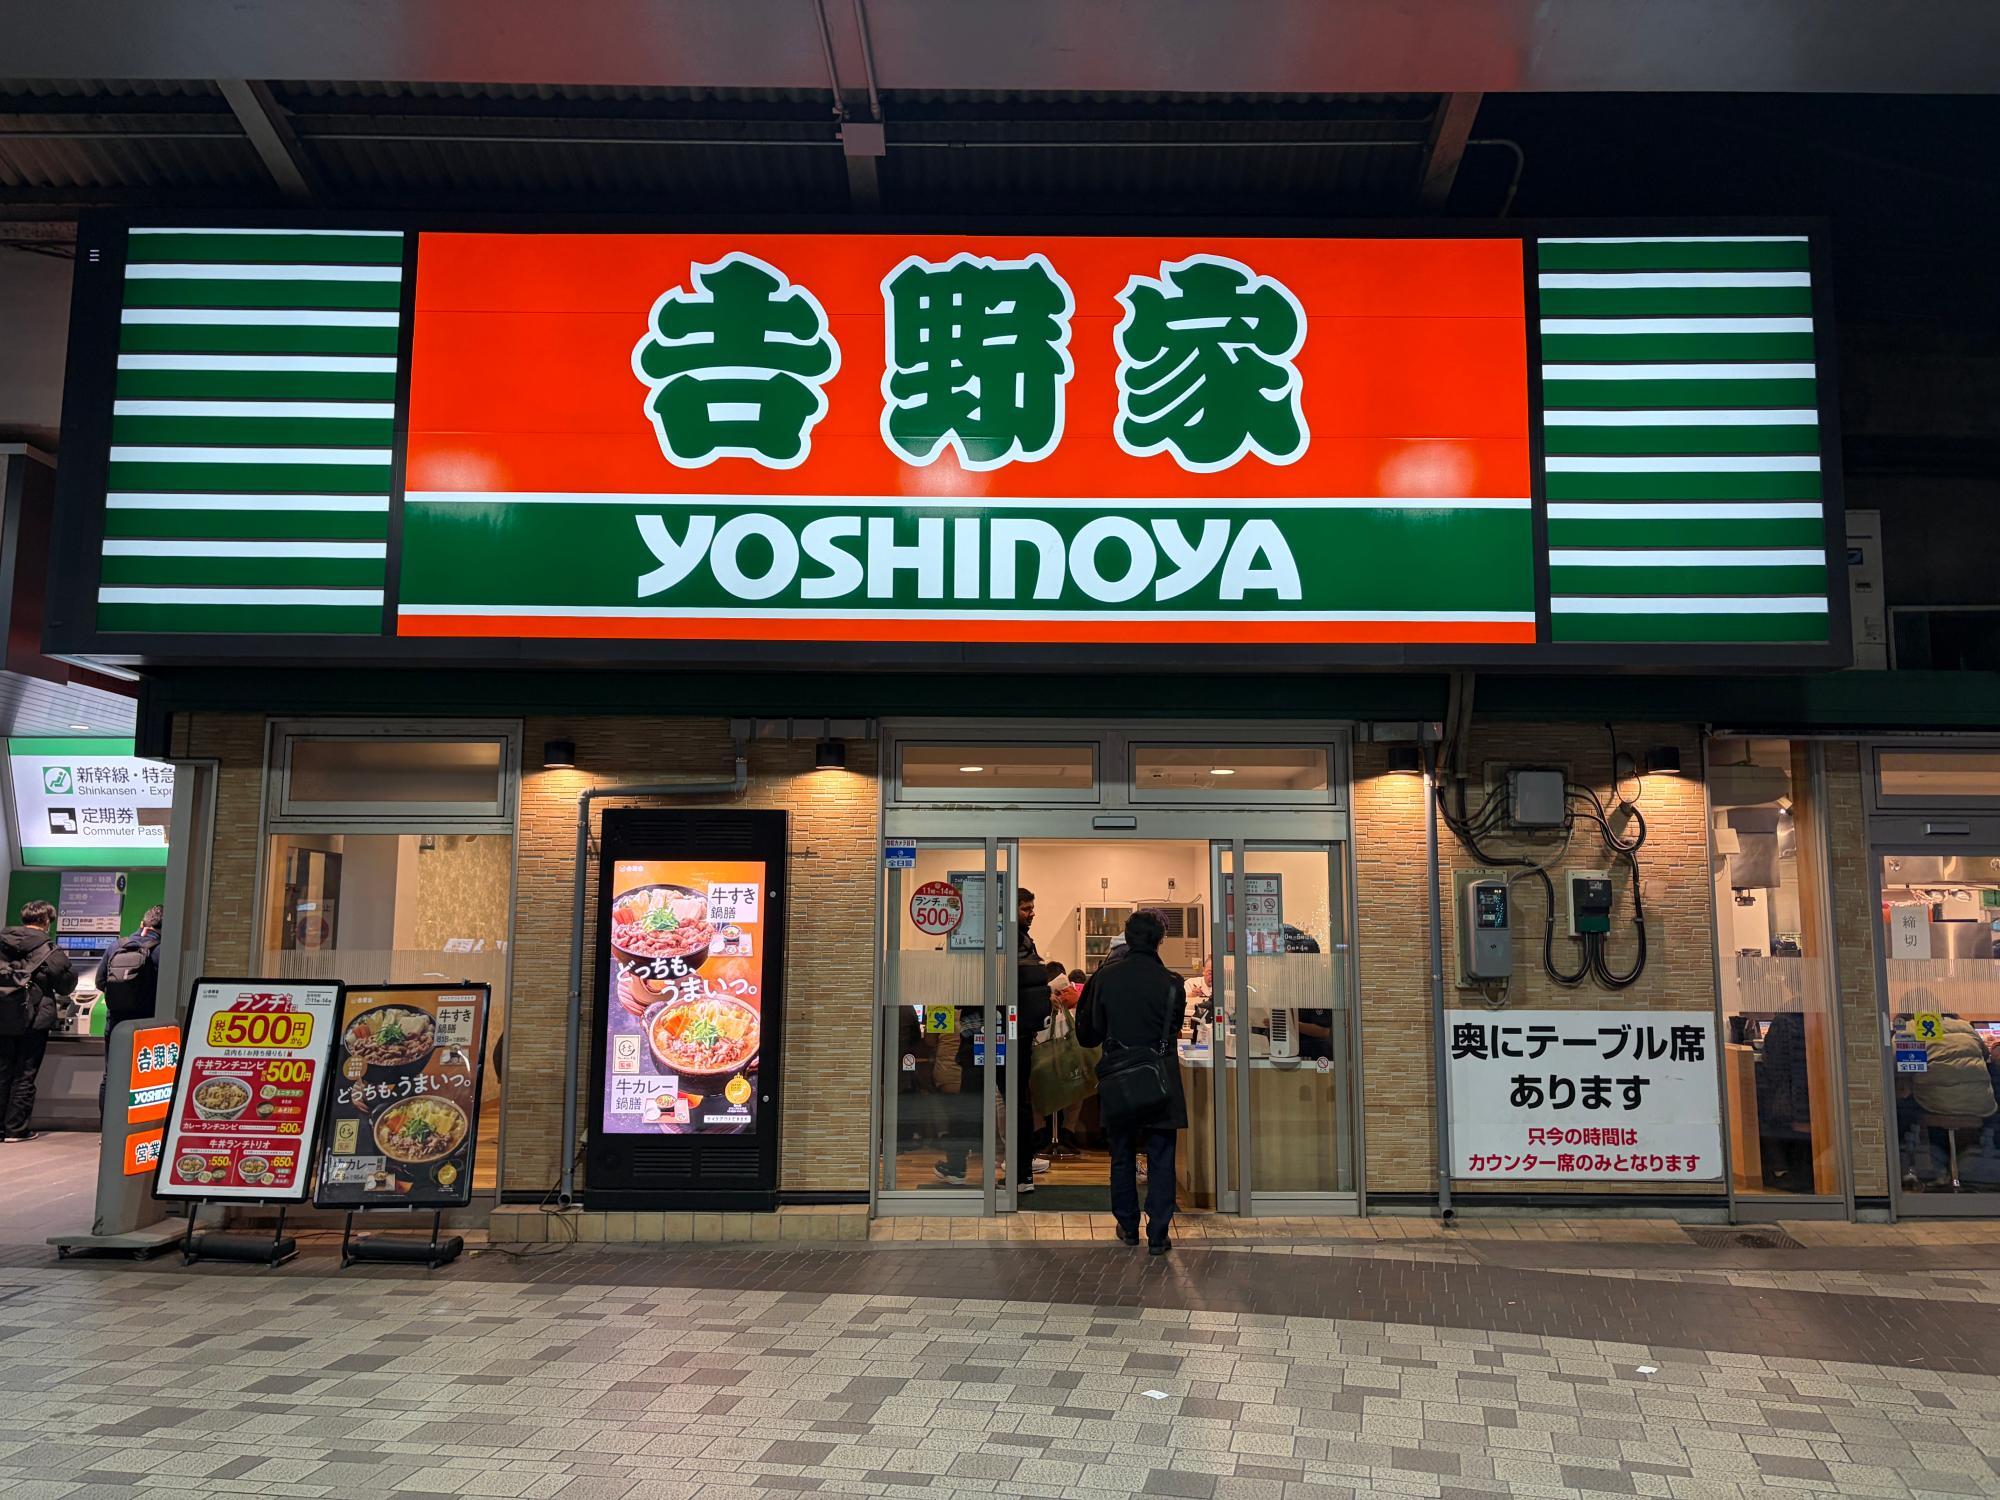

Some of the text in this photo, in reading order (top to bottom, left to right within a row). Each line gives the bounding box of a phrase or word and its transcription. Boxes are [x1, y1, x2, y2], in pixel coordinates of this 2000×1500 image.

[631, 252, 1310, 473] 吉野家
[635, 513, 1302, 602] YOSHINOYA
[78, 786, 137, 796] Shinkansen
[81, 808, 134, 824] 定期券
[83, 827, 163, 836] Commuter Pass
[711, 887, 756, 905] 牛すき
[915, 896, 940, 906] ランチ
[710, 906, 736, 919] 鍋膳
[616, 956, 698, 982] どっちも、
[661, 977, 758, 1006] うまいっ。
[236, 992, 284, 1012] ランチ
[439, 1008, 472, 1023] 牛すき
[1451, 1023, 1706, 1062] 奥にテーブル席
[195, 1059, 266, 1070] 牛丼ランチコンビ
[615, 1078, 673, 1095] 牛カレー
[1510, 1074, 1650, 1111] あります
[615, 1097, 642, 1111] 鍋膳
[209, 1139, 271, 1149] 牛丼ランチトリオ
[1528, 1127, 1638, 1147] 只今の時間は
[1469, 1153, 1701, 1174] カウンター席のみとなります
